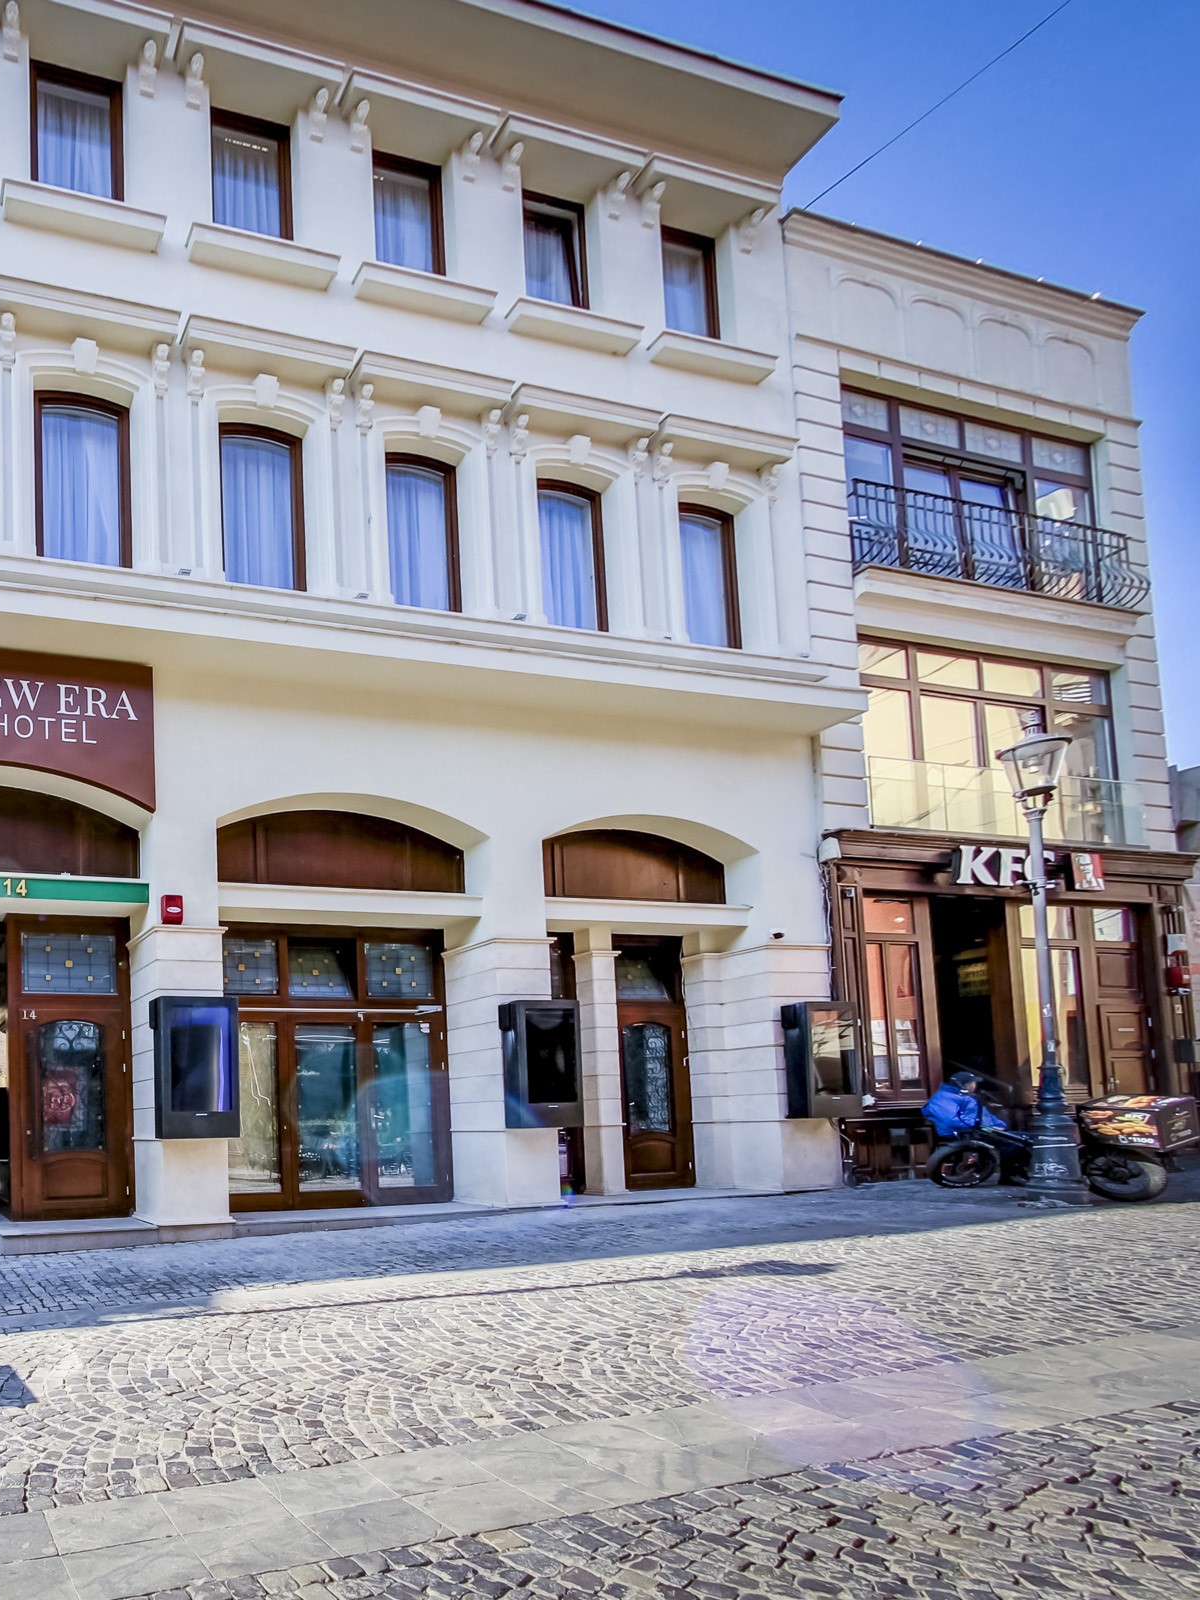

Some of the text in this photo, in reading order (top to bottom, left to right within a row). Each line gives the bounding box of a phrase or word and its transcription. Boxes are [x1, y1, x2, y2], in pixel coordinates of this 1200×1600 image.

[56, 683, 138, 721] ERA
[3, 877, 28, 897] 14
[21, 1009, 37, 1020] 14
